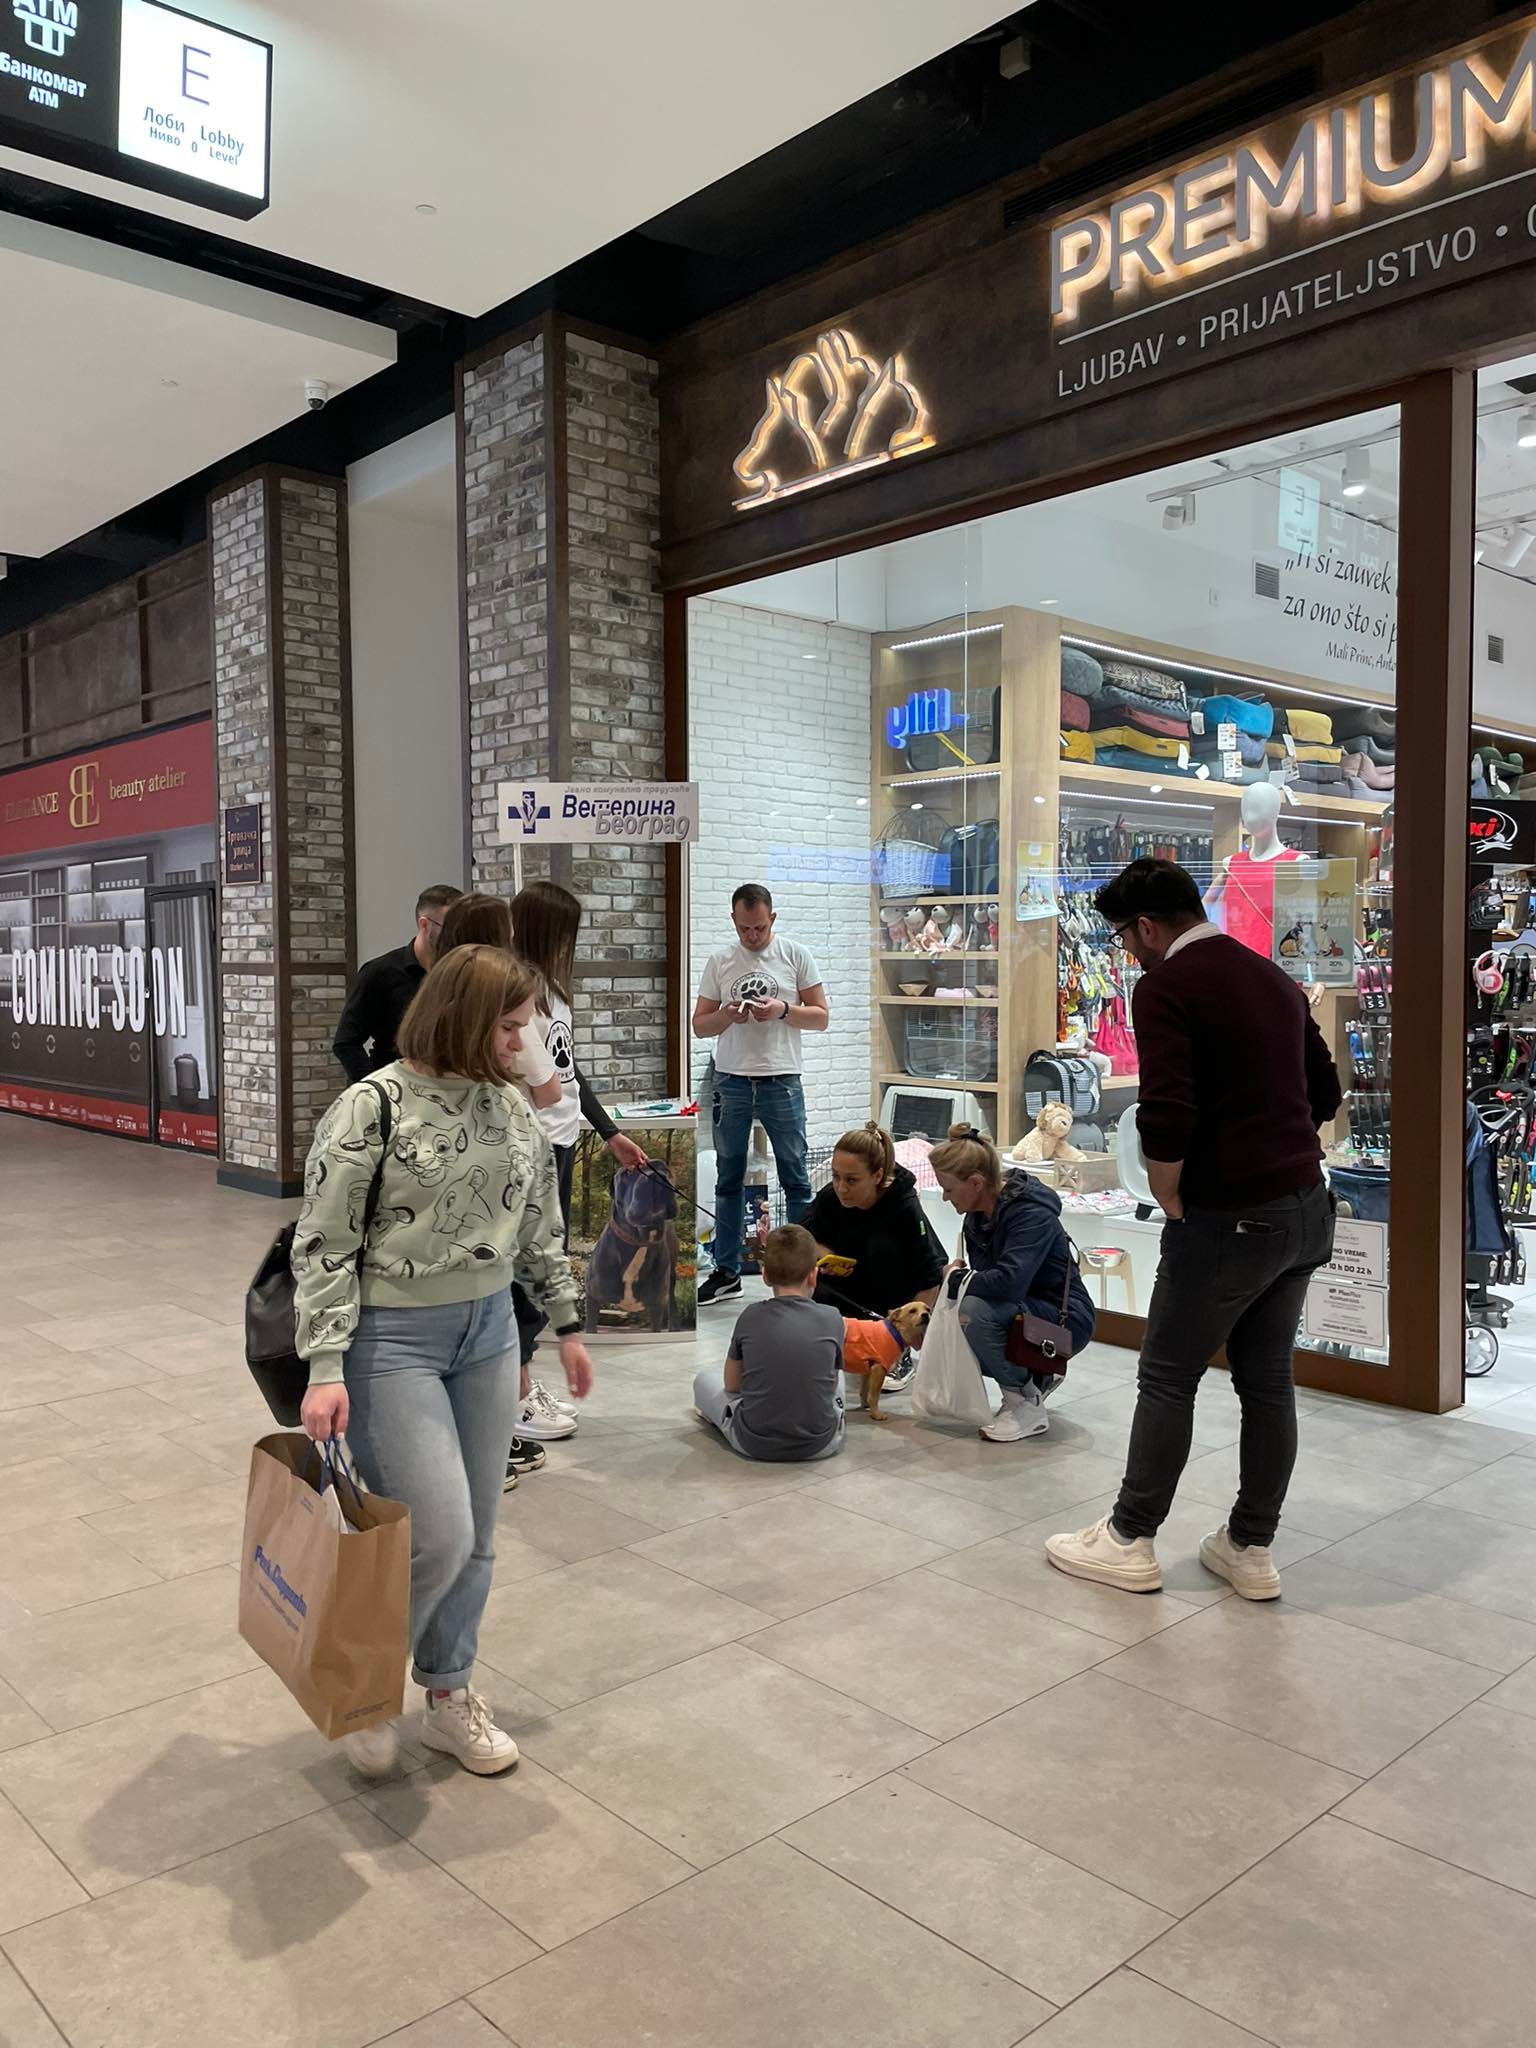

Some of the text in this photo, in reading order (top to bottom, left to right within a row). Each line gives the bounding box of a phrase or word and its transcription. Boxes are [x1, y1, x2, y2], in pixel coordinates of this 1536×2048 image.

[182, 43, 211, 106] E
[28, 86, 59, 108] ATM
[143, 106, 245, 156] Лоби Lobby
[149, 126, 181, 146] Ниво
[209, 147, 239, 165] Level
[1050, 26, 1536, 316] PREMIUM
[1057, 226, 1477, 398] LJUBAV PRIJATELJSTVO
[1315, 547, 1333, 574] si
[1334, 560, 1392, 595] zauvek
[1283, 595, 1306, 618] za
[1310, 602, 1341, 626] ono
[1344, 602, 1370, 634] što
[1372, 612, 1389, 638] si
[1326, 641, 1349, 660] Mali
[109, 778, 146, 802] beauty
[149, 766, 187, 792] atelier
[595, 809, 690, 840] Београд
[12, 945, 187, 1038] COMING SOON
[1344, 1265, 1355, 1273] DO
[1356, 1266, 1366, 1275] 22
